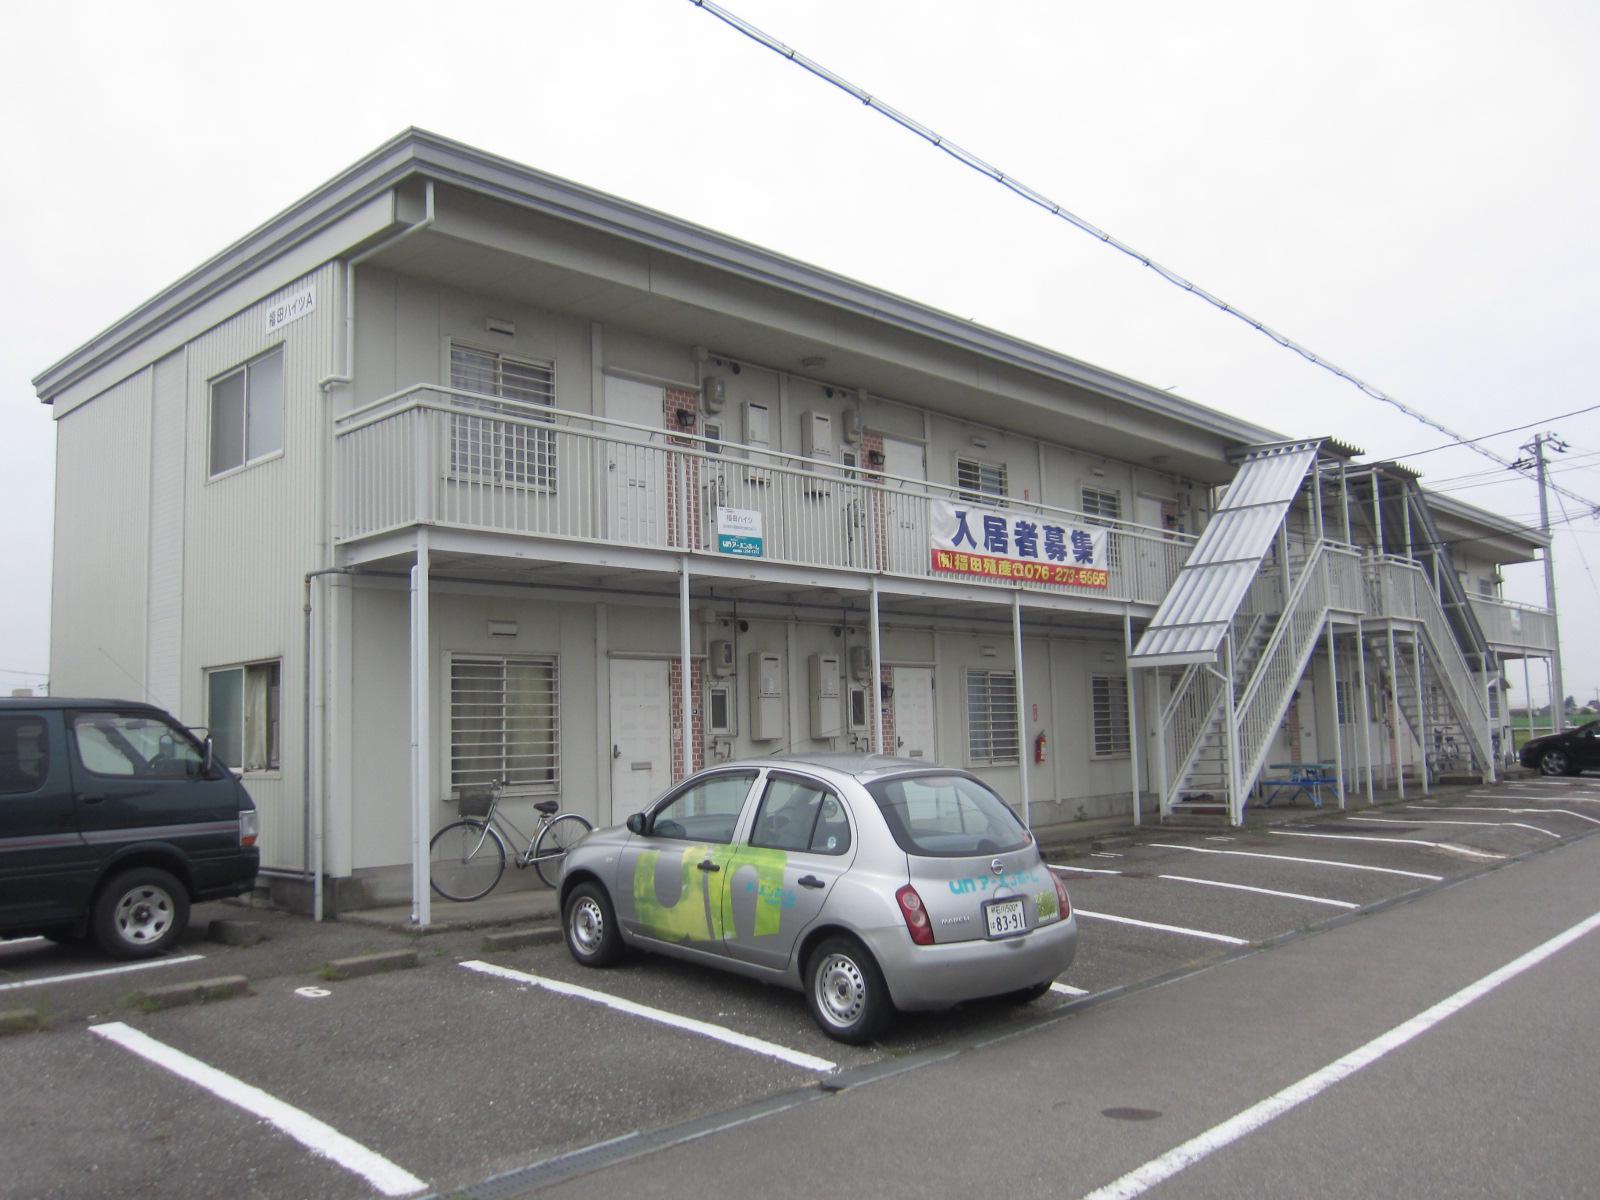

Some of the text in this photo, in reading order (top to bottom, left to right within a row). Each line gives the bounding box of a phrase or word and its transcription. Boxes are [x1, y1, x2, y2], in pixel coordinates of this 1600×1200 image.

[951, 510, 1094, 565] 入居者募集
